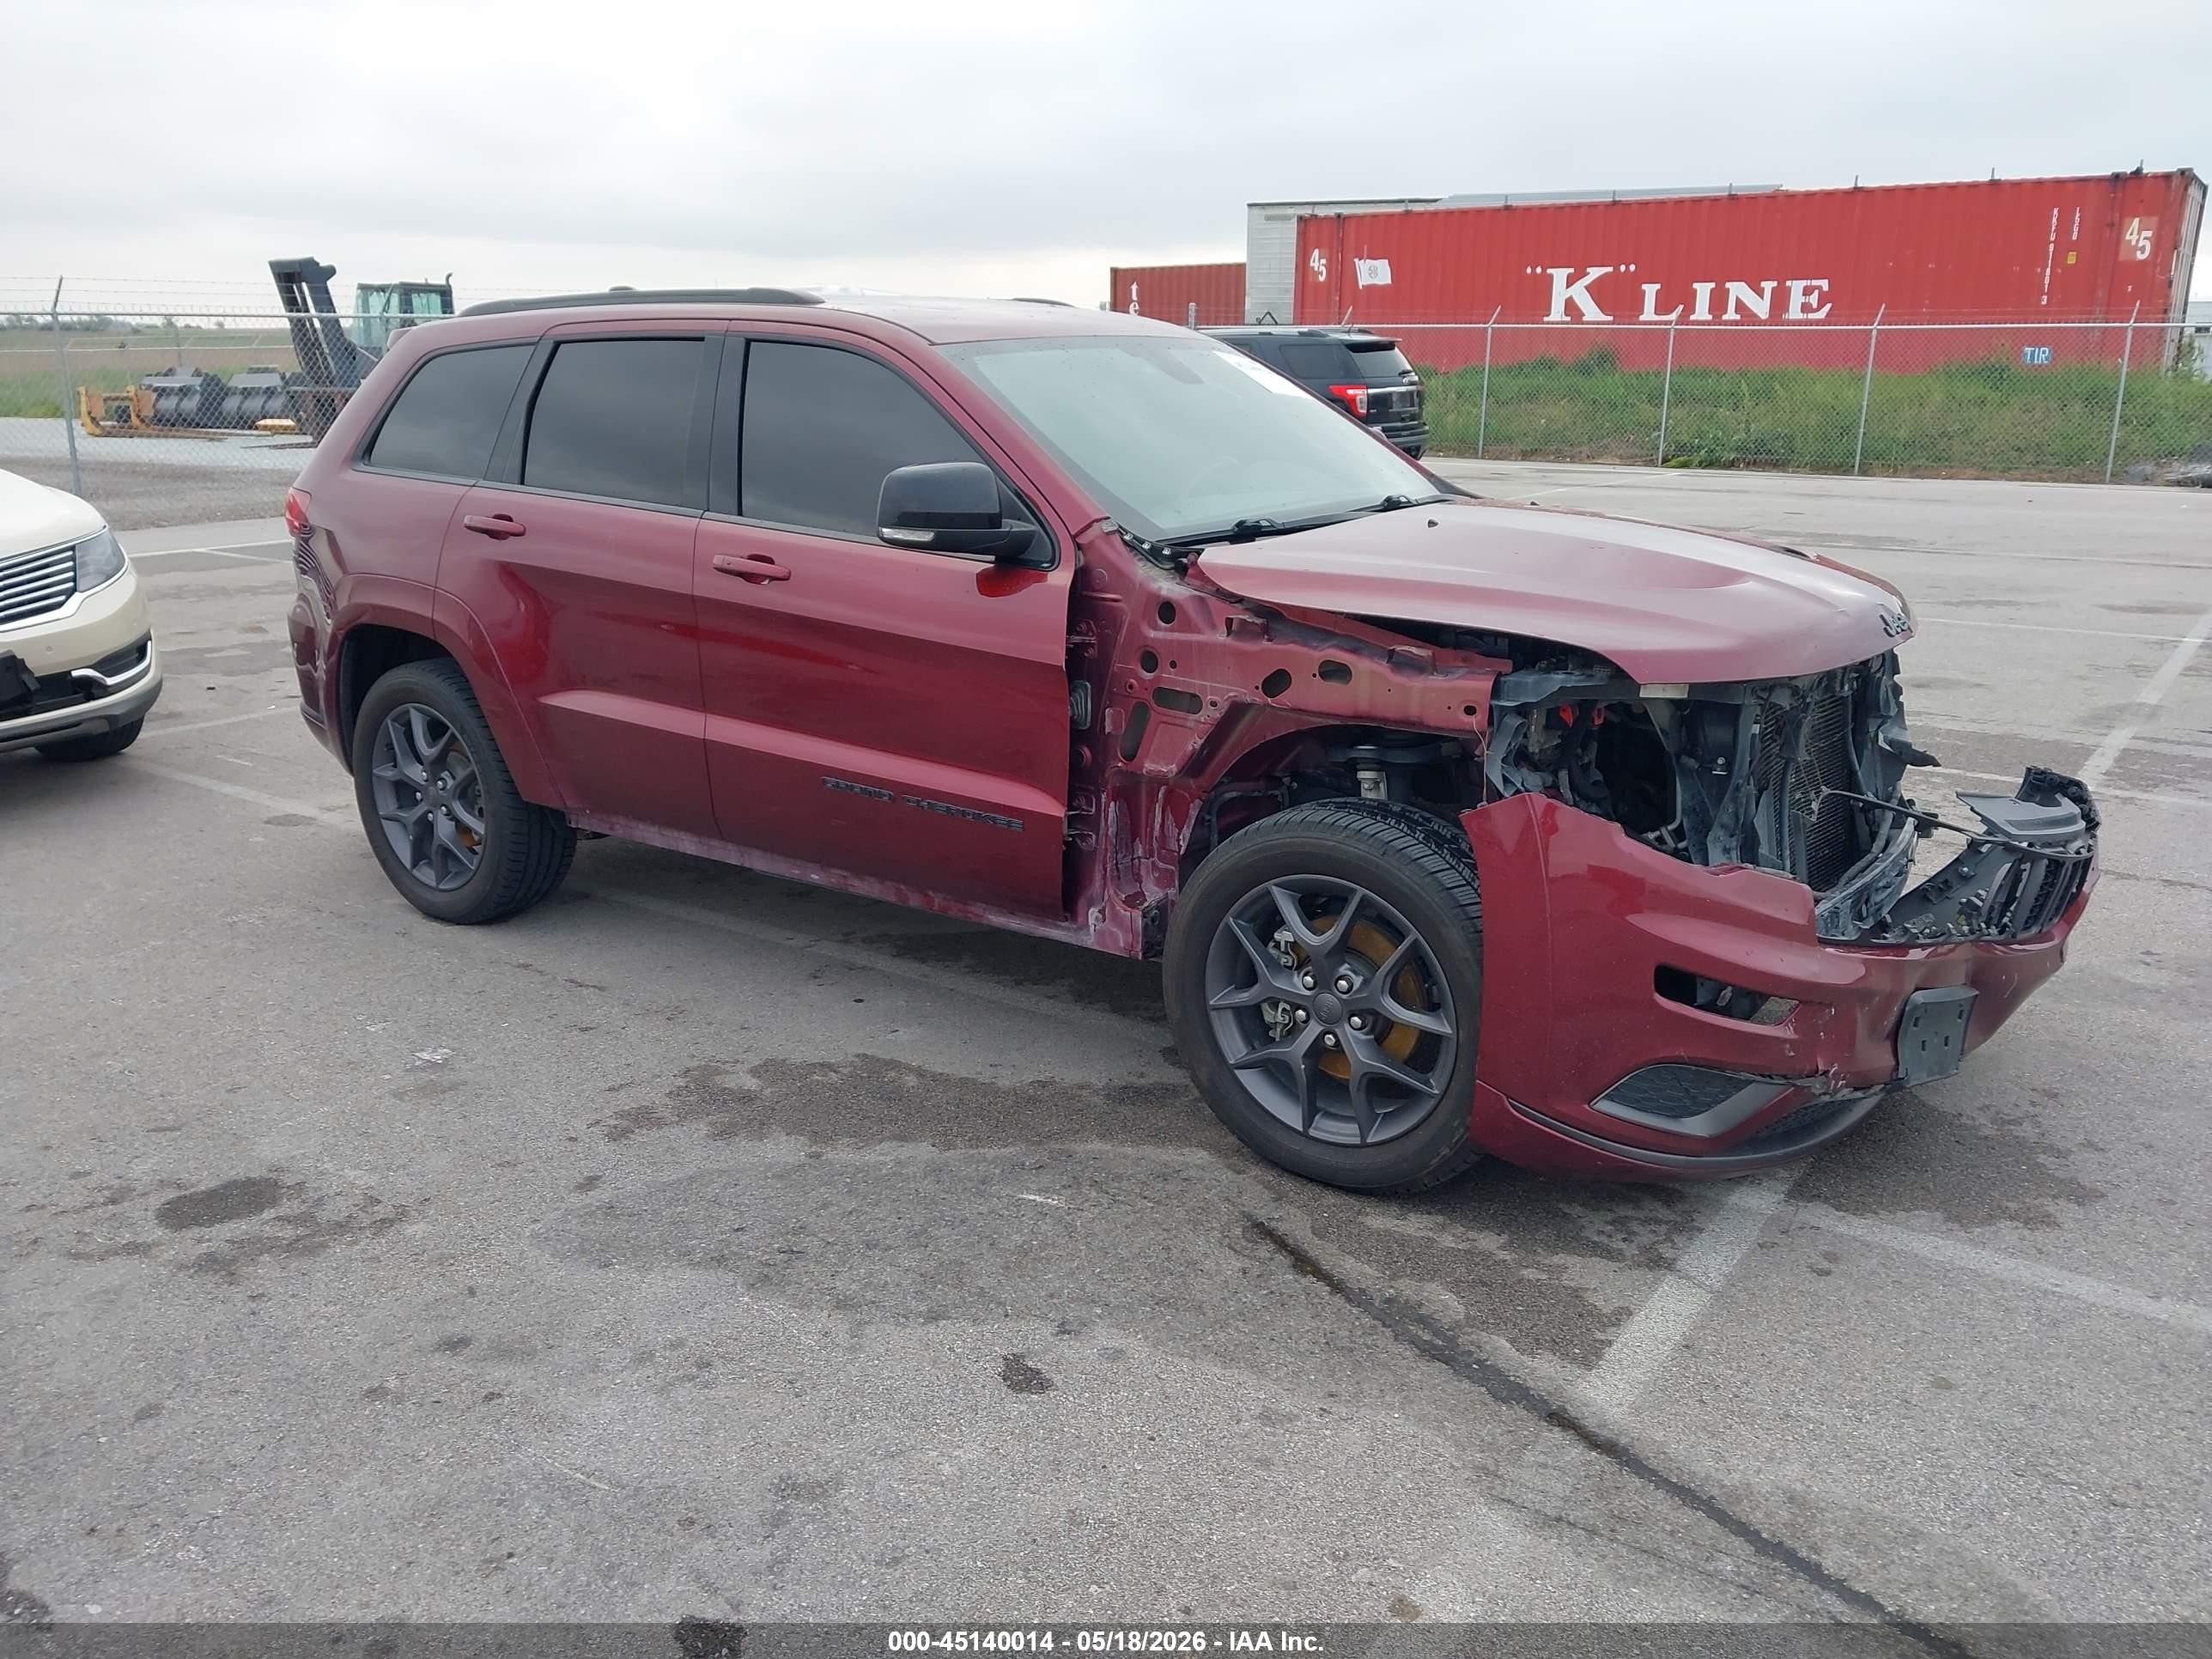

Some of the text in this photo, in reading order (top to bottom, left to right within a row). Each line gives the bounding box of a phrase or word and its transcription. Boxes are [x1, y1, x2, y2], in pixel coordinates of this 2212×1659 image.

[2125, 217, 2153, 260] 45
[1310, 248, 1327, 282] 45
[1638, 278, 1833, 320] LINE
[2025, 347, 2049, 364] TIR
[822, 776, 1024, 831] GRAND CHEROKEE
